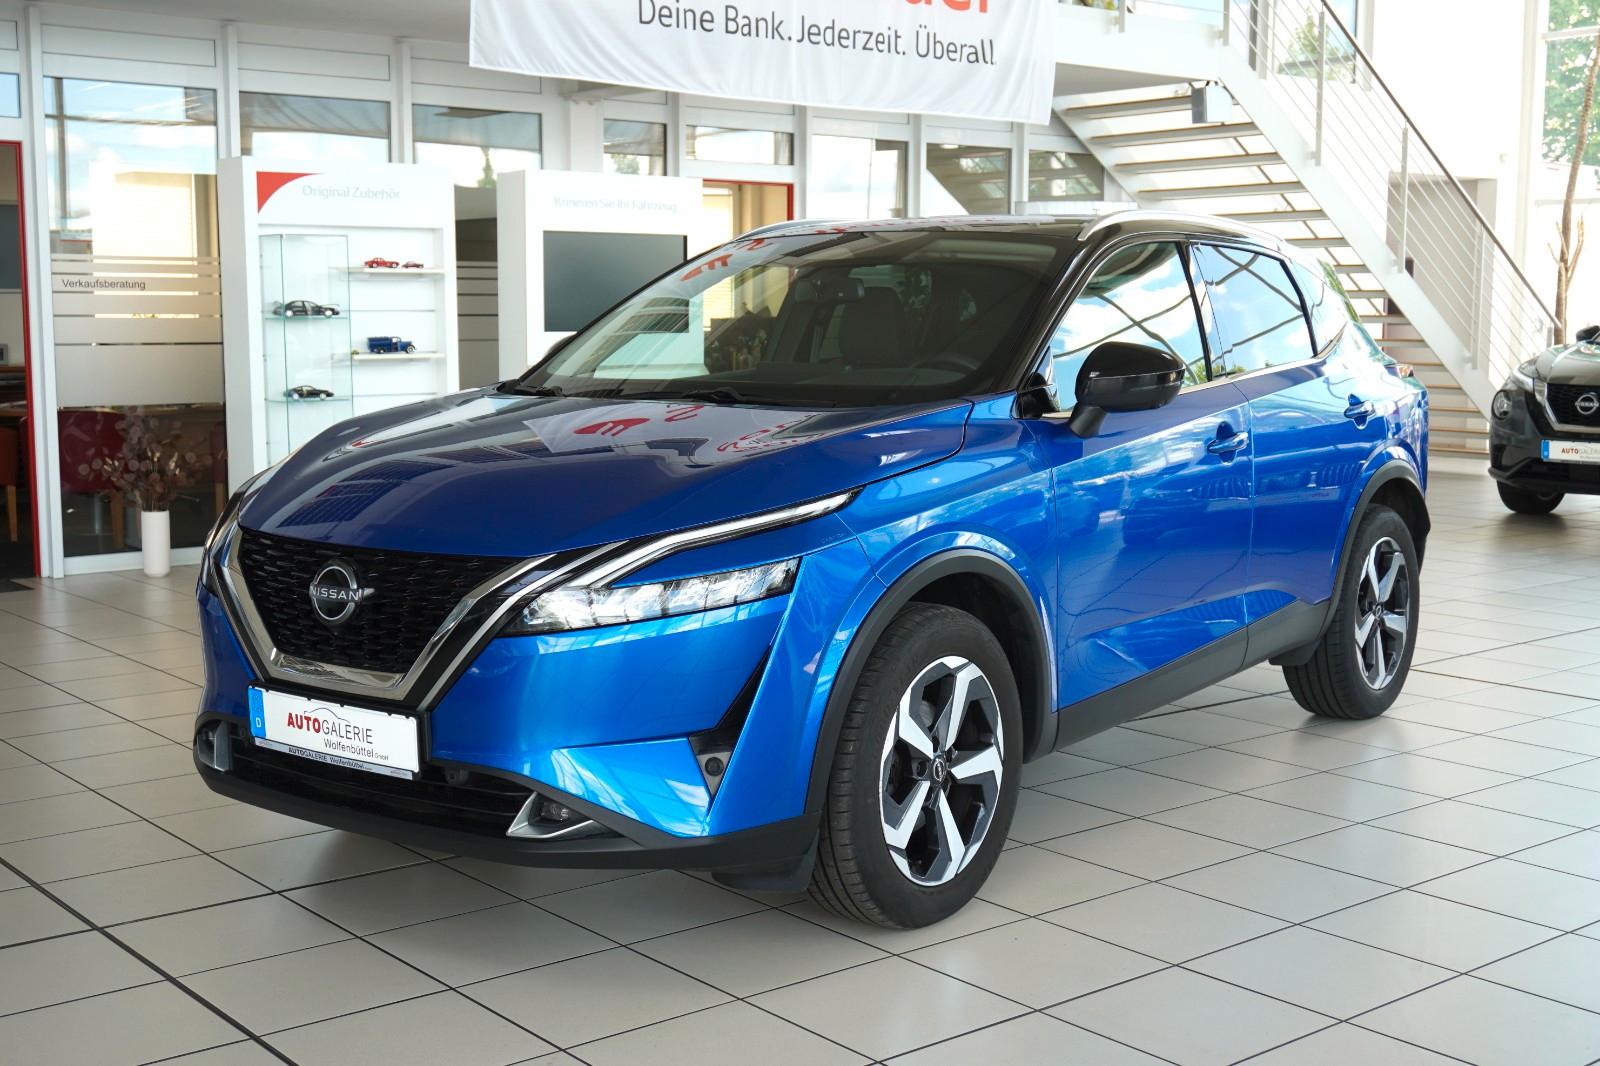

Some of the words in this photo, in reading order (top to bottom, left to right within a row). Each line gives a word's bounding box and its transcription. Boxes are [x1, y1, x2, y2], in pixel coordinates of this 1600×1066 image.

[638, 0, 715, 33] Deine
[724, 5, 793, 41] Bank.
[796, 16, 906, 56] Jederzeit.
[302, 184, 350, 200] Original
[352, 186, 401, 200] Zubehör
[62, 279, 146, 290] Verkaufsberatung
[310, 586, 362, 601] NISSAN
[255, 717, 262, 728] D
[287, 712, 373, 744] AUTOGALERIE
[288, 746, 328, 762] AUTOGALERIE
[323, 738, 374, 758] Wolfenbüttel
